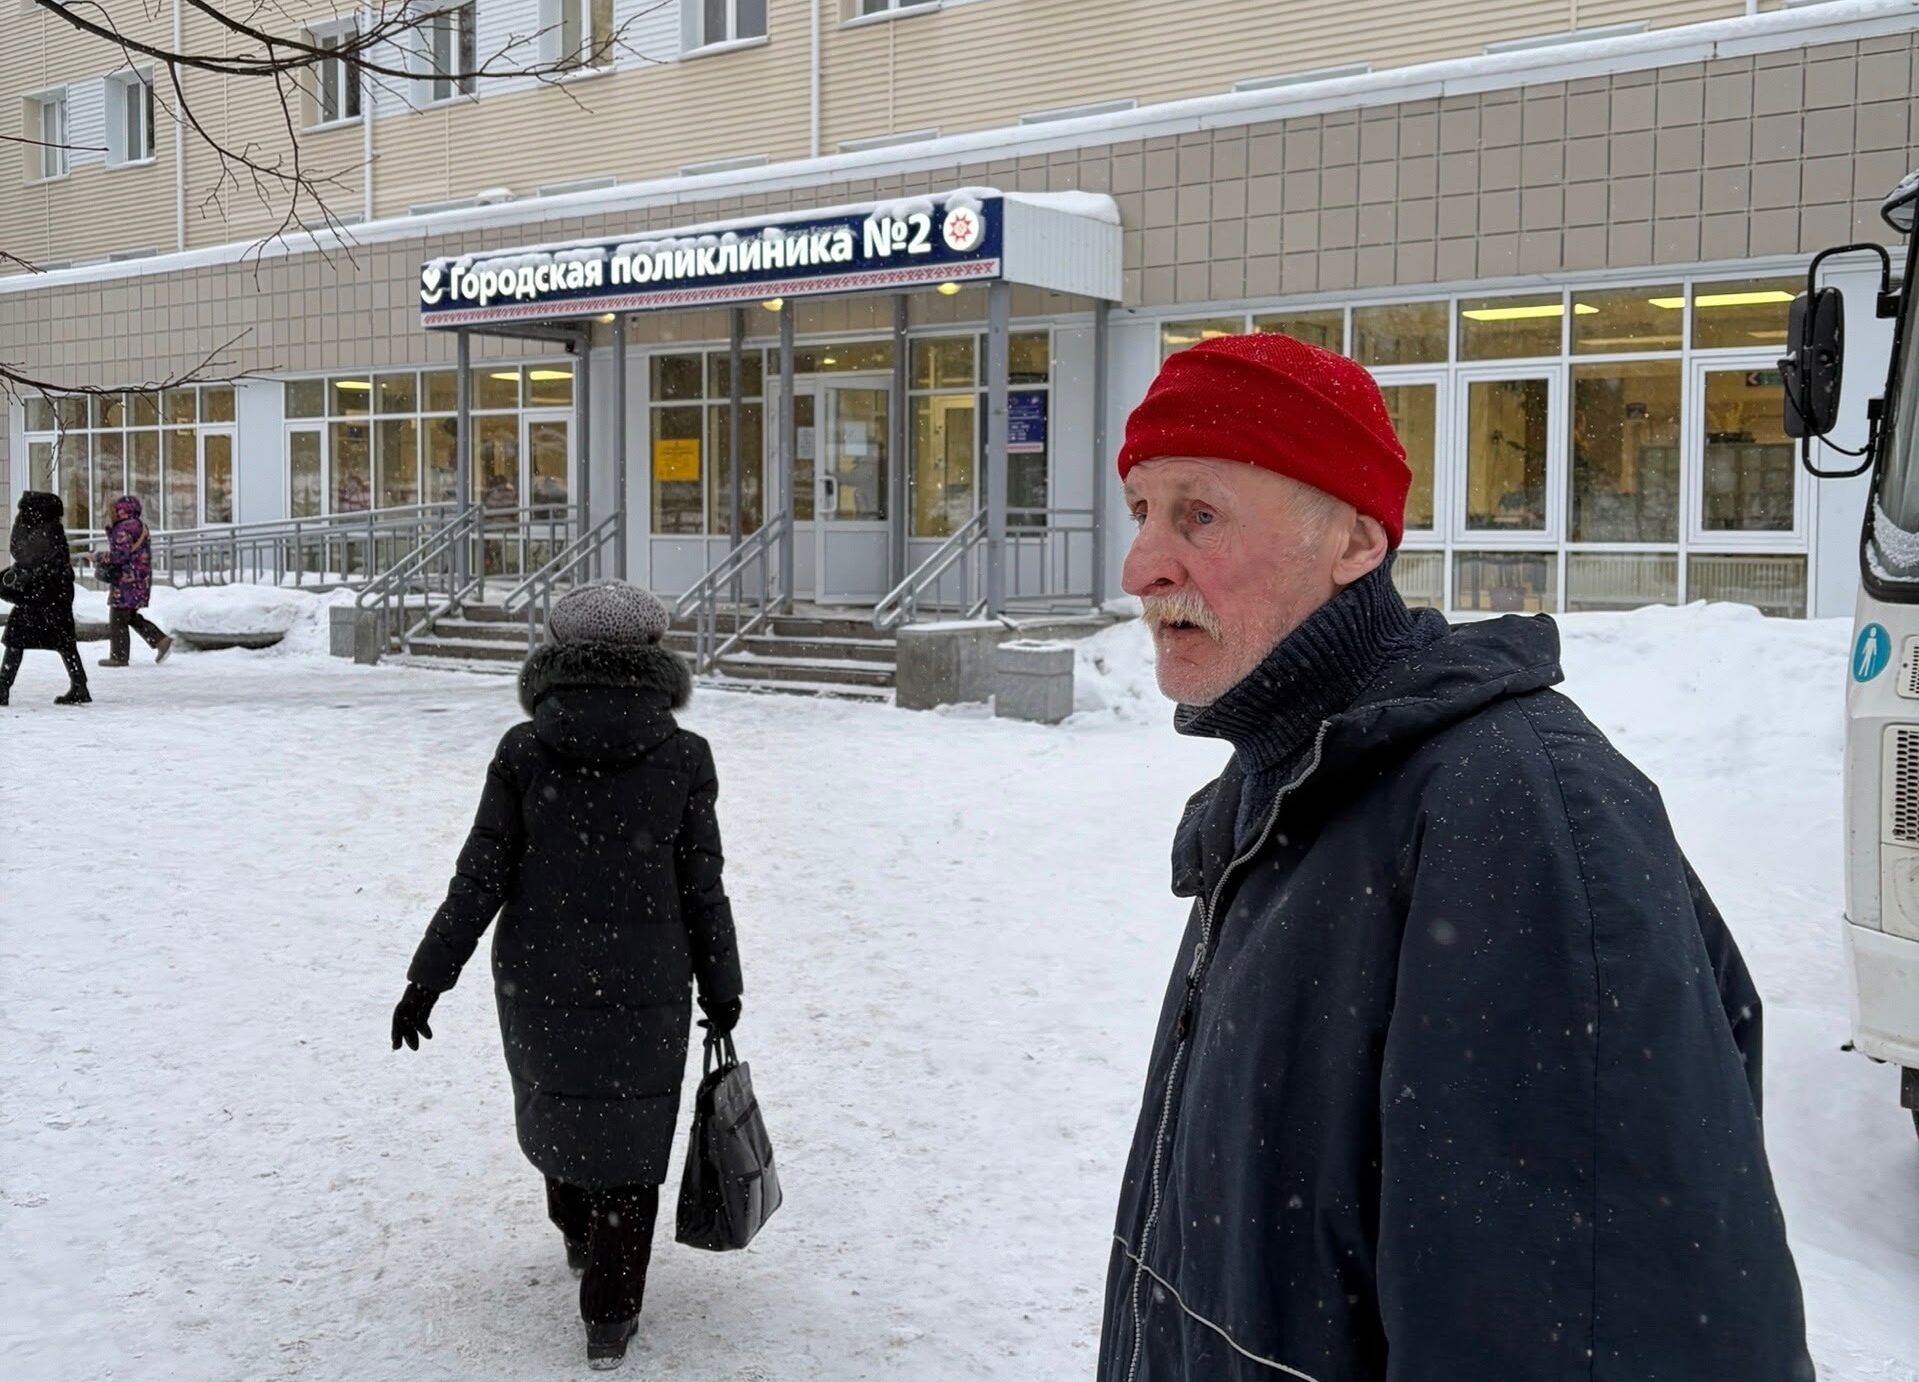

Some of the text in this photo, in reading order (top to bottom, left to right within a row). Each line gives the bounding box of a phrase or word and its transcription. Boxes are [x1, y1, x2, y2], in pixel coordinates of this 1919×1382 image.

[450, 213, 931, 306] Городская поликлиника №2
